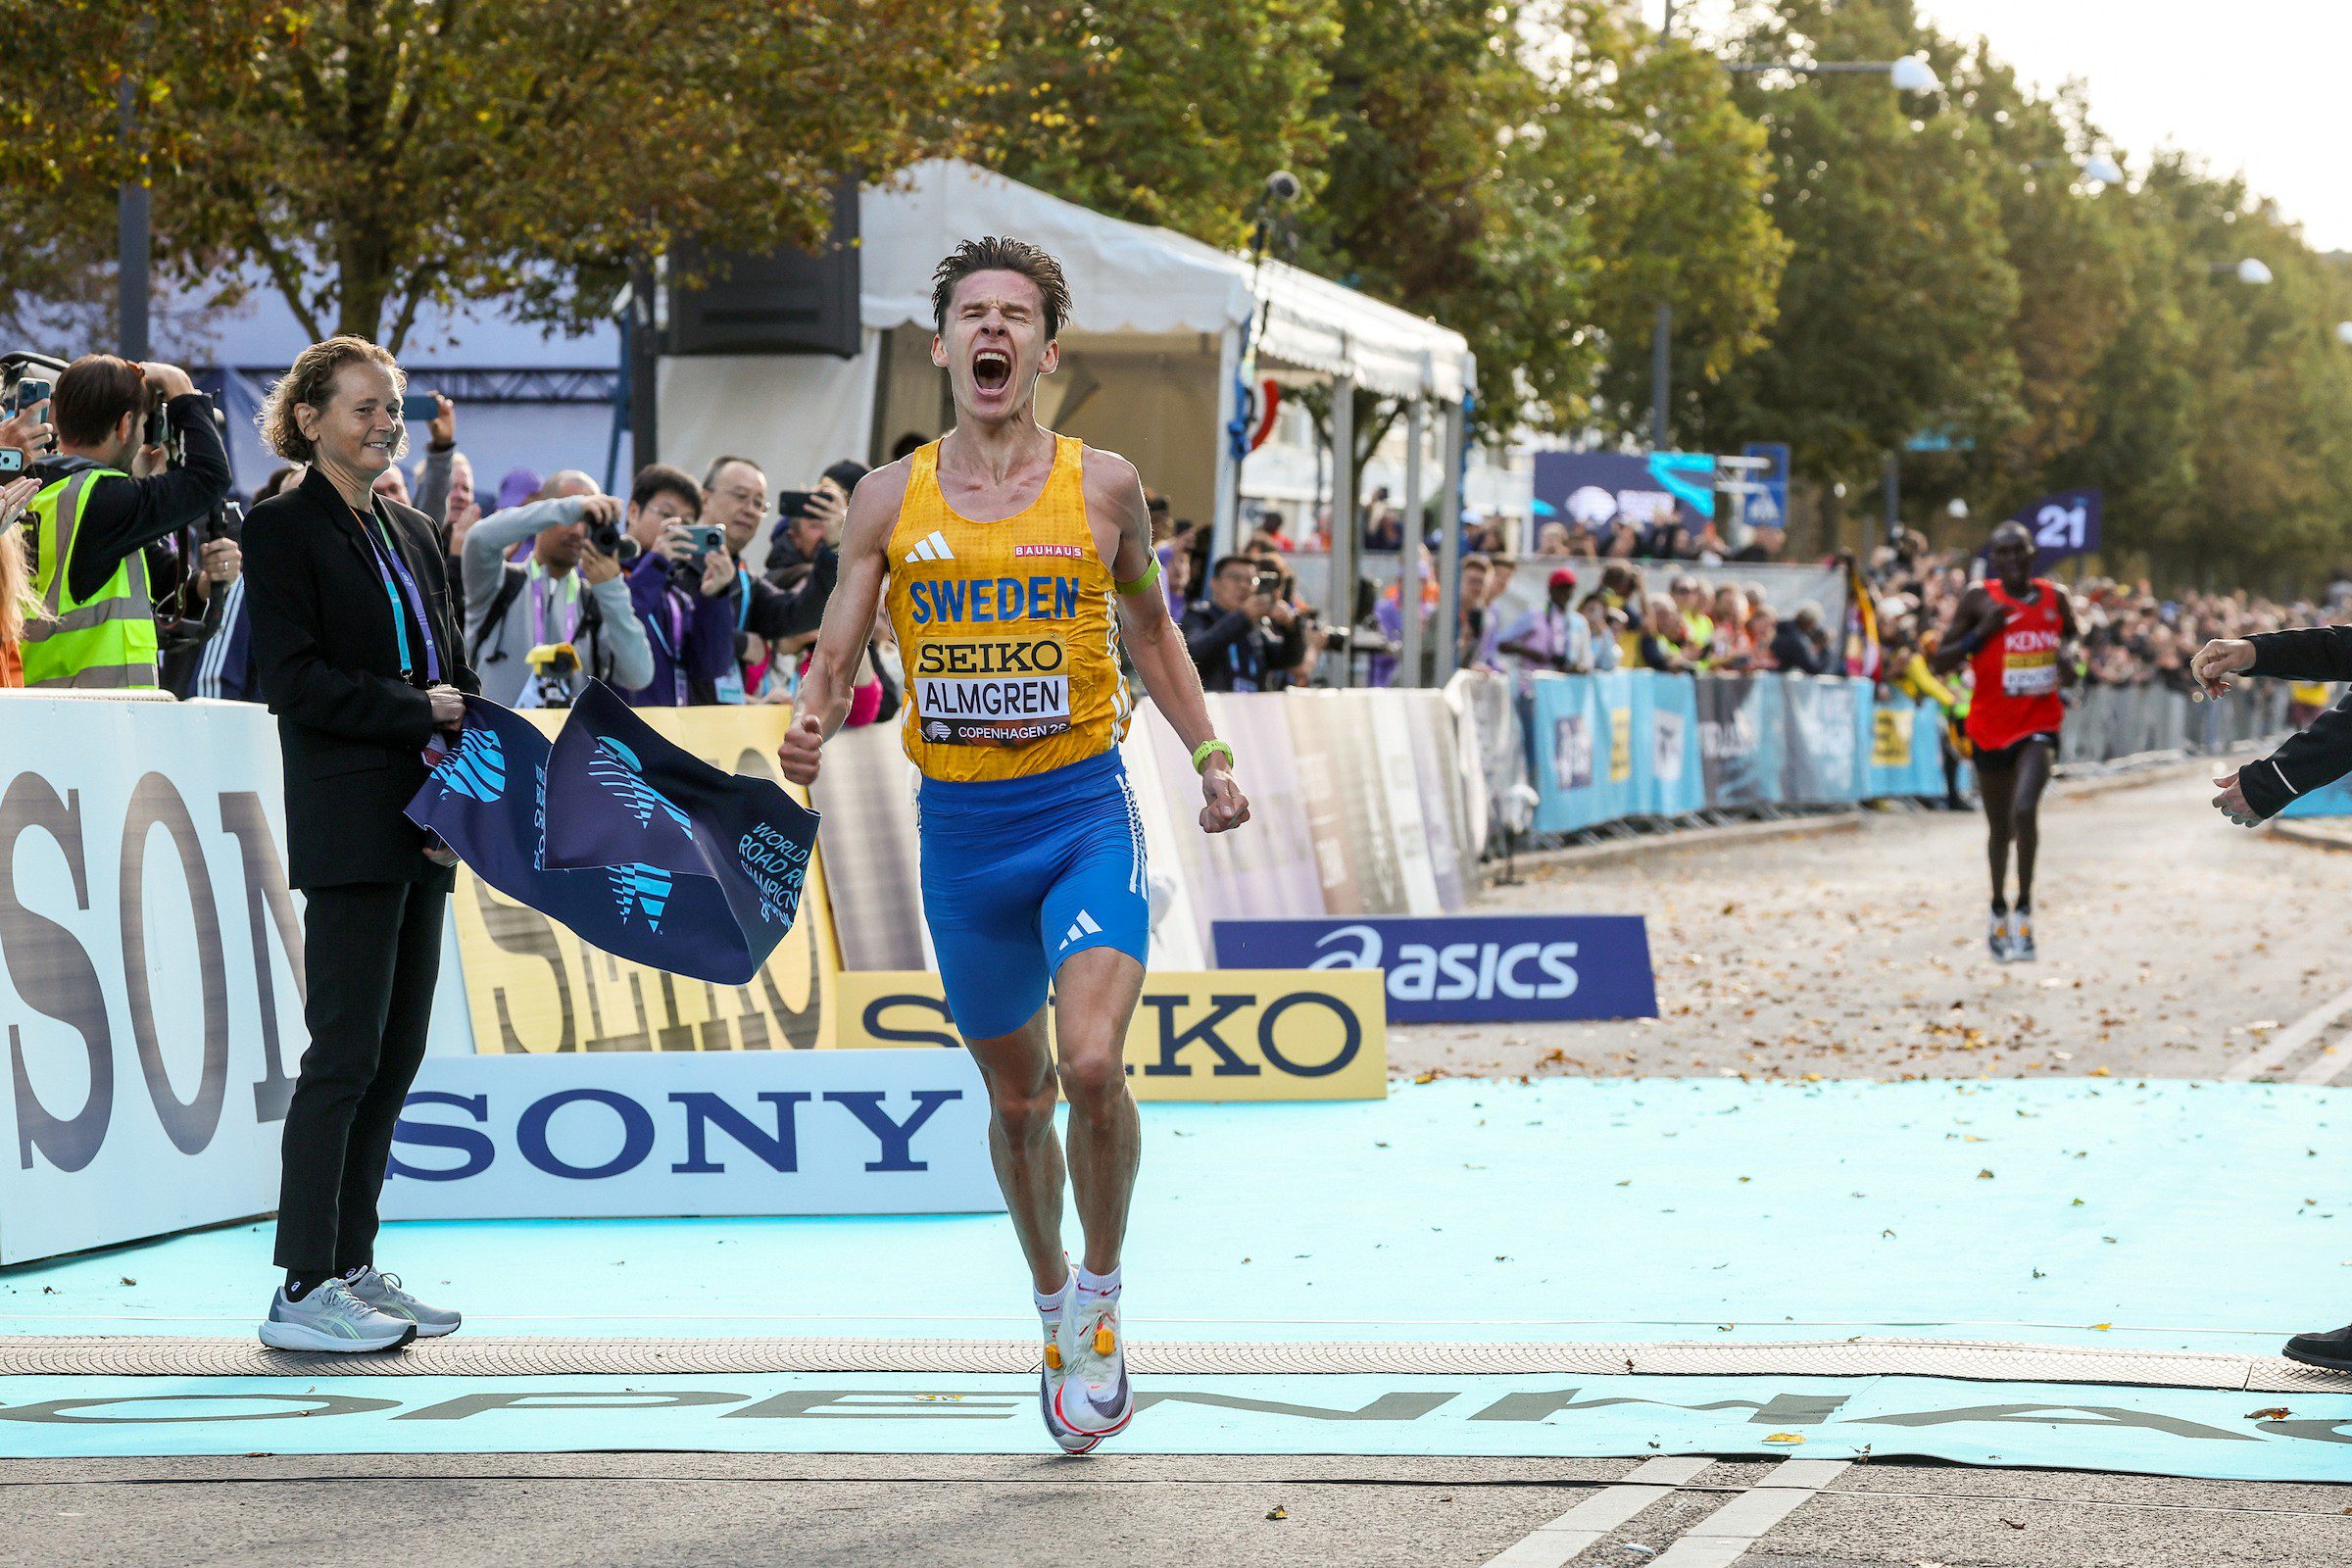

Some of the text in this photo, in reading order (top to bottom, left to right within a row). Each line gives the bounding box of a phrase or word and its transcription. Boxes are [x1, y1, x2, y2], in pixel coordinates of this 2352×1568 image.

[2035, 504, 2086, 548] 21
[1015, 546, 1082, 557] BAUHAUS
[909, 576, 1079, 624] SWEDEN
[918, 640, 1062, 673] SEIKO
[2004, 631, 2058, 653] KENY
[925, 680, 1059, 714] ALMGREN
[957, 725, 1047, 739] COPENHAGEN
[739, 834, 806, 889] ROAD RU
[753, 822, 808, 862] WORLD
[0, 771, 307, 1172] SON
[862, 992, 1361, 1077] SIKO
[383, 1088, 962, 1182] SONY
[0, 1388, 2352, 1444] OPENHA
